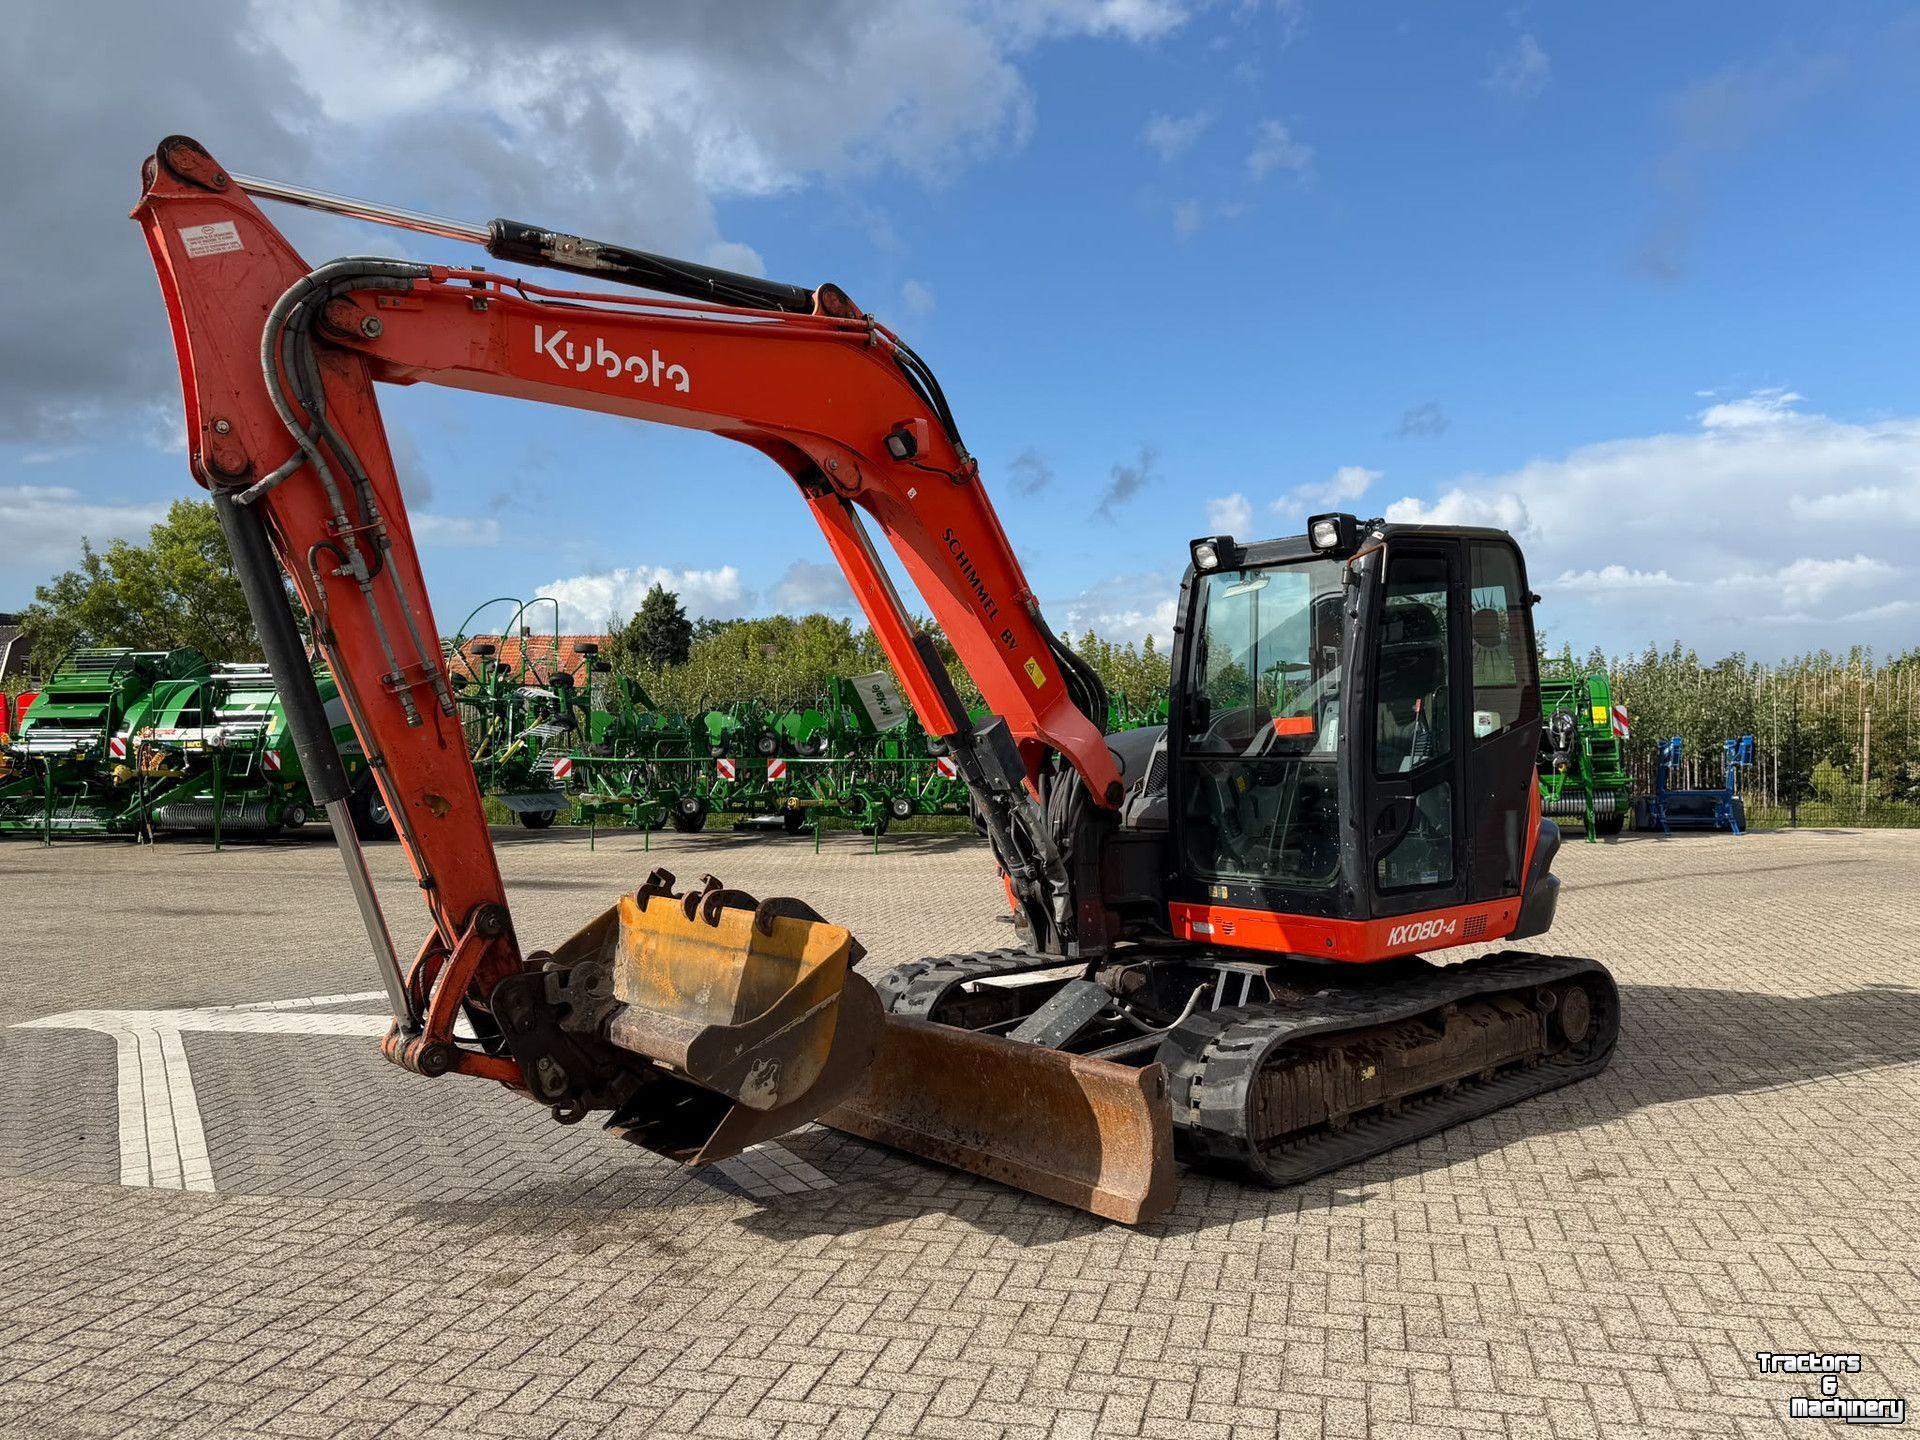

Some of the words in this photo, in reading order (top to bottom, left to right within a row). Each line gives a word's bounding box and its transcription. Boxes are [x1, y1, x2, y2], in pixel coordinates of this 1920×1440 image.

[534, 324, 690, 392] Kubota
[942, 527, 1000, 622] SCHIMMEL
[1000, 628, 1019, 650] BV
[1387, 918, 1457, 946] KX080-4
